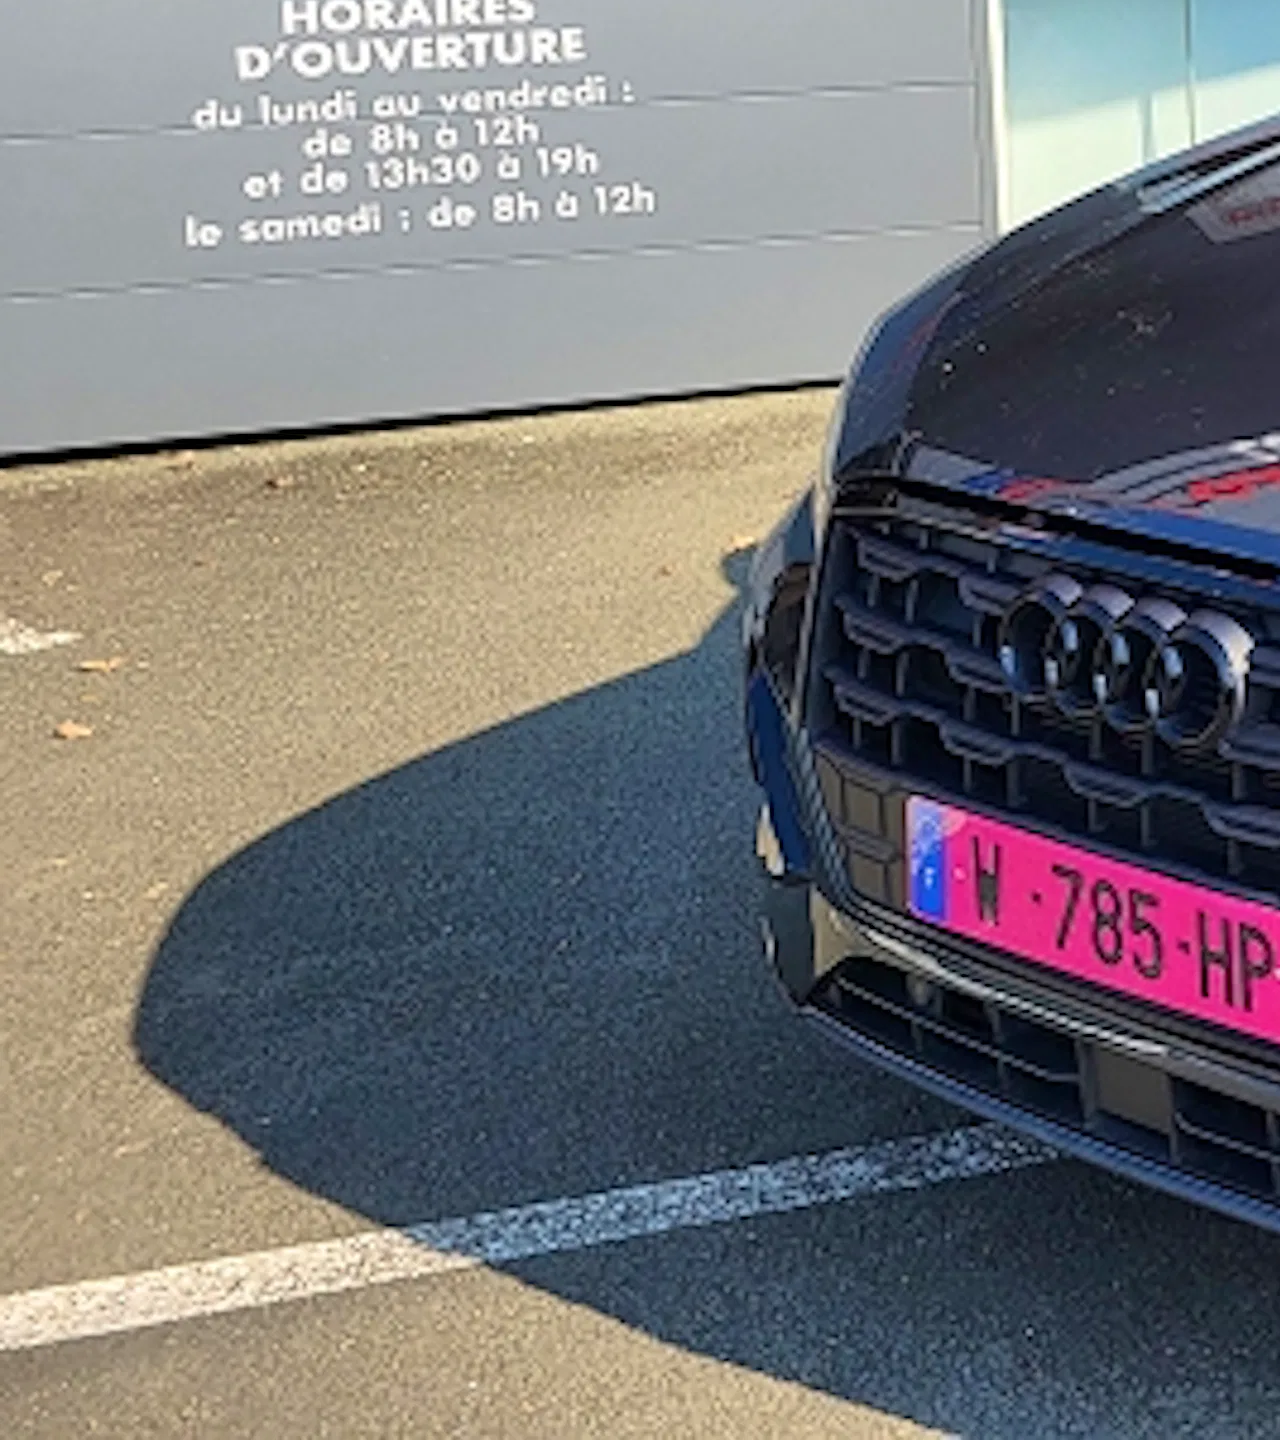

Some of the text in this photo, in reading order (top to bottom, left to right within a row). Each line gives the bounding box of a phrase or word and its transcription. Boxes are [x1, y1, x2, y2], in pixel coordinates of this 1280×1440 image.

[234, 28, 589, 80] D'OUVERTURE
[193, 99, 242, 129] du
[258, 91, 358, 127] lundi
[372, 94, 420, 119] au
[438, 76, 607, 114] vendredi
[303, 115, 541, 159] de 8h à 12h
[243, 145, 600, 200] et de 13h30 à 19h
[184, 216, 221, 248] le
[239, 202, 382, 244] samedi
[428, 197, 476, 229] de
[492, 193, 541, 224] 8h
[555, 192, 579, 219] à
[593, 182, 656, 216] 12h
